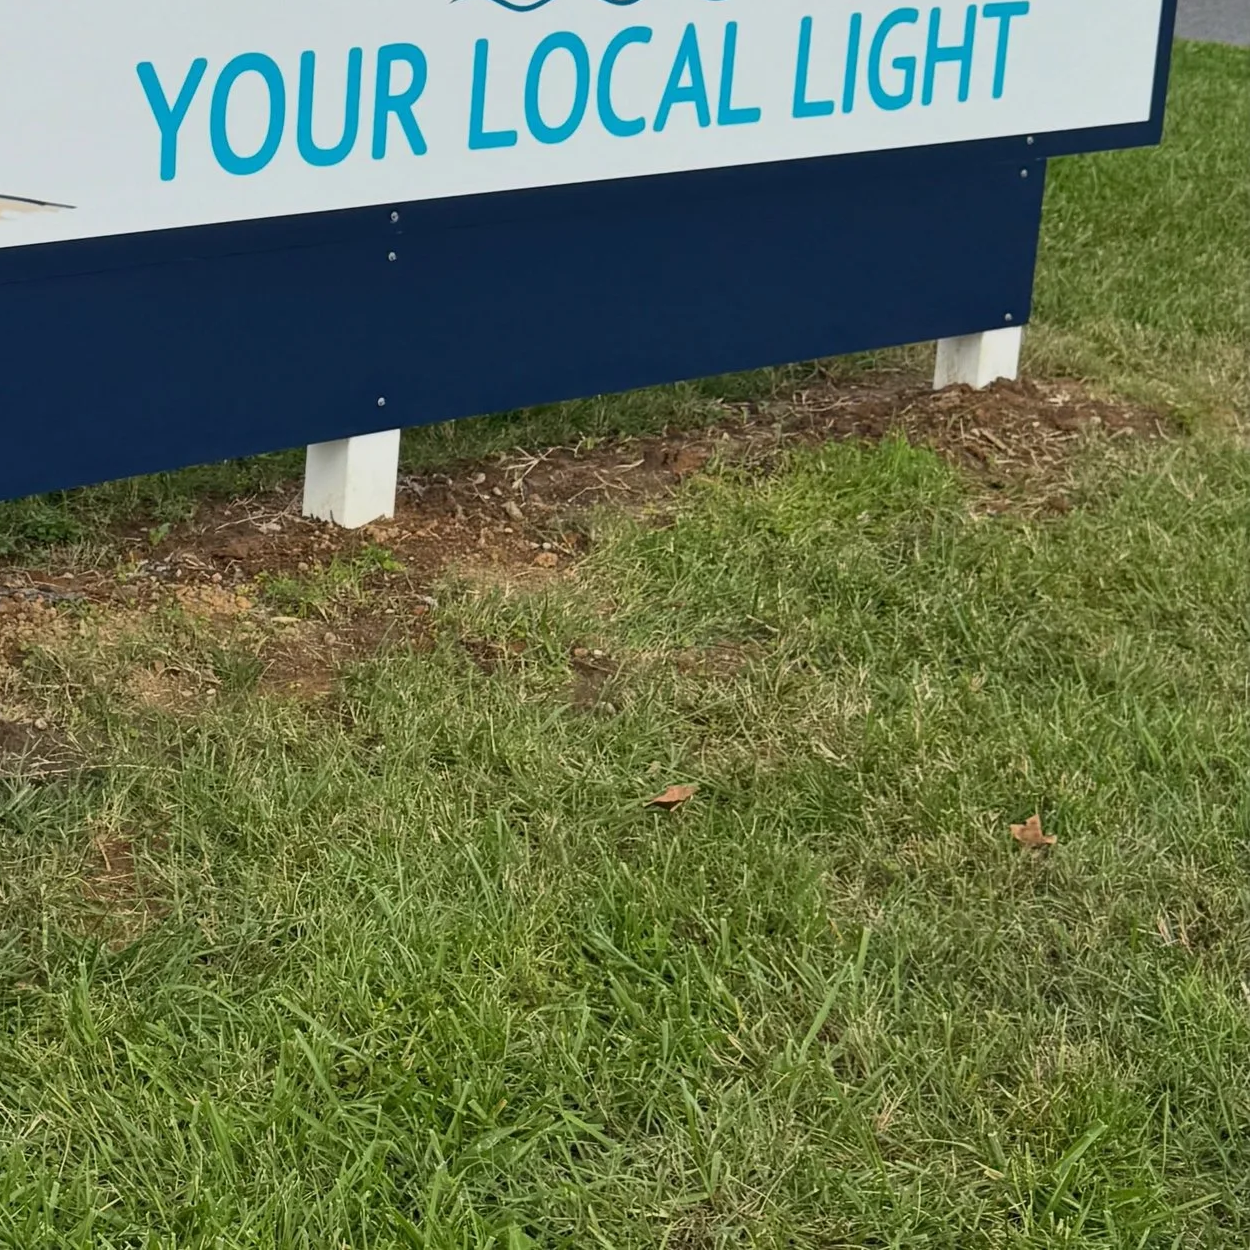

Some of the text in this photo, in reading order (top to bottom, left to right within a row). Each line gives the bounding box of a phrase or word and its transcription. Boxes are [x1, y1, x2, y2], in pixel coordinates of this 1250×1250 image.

[135, 0, 1031, 182] YOUR LOCAL LIGHT
